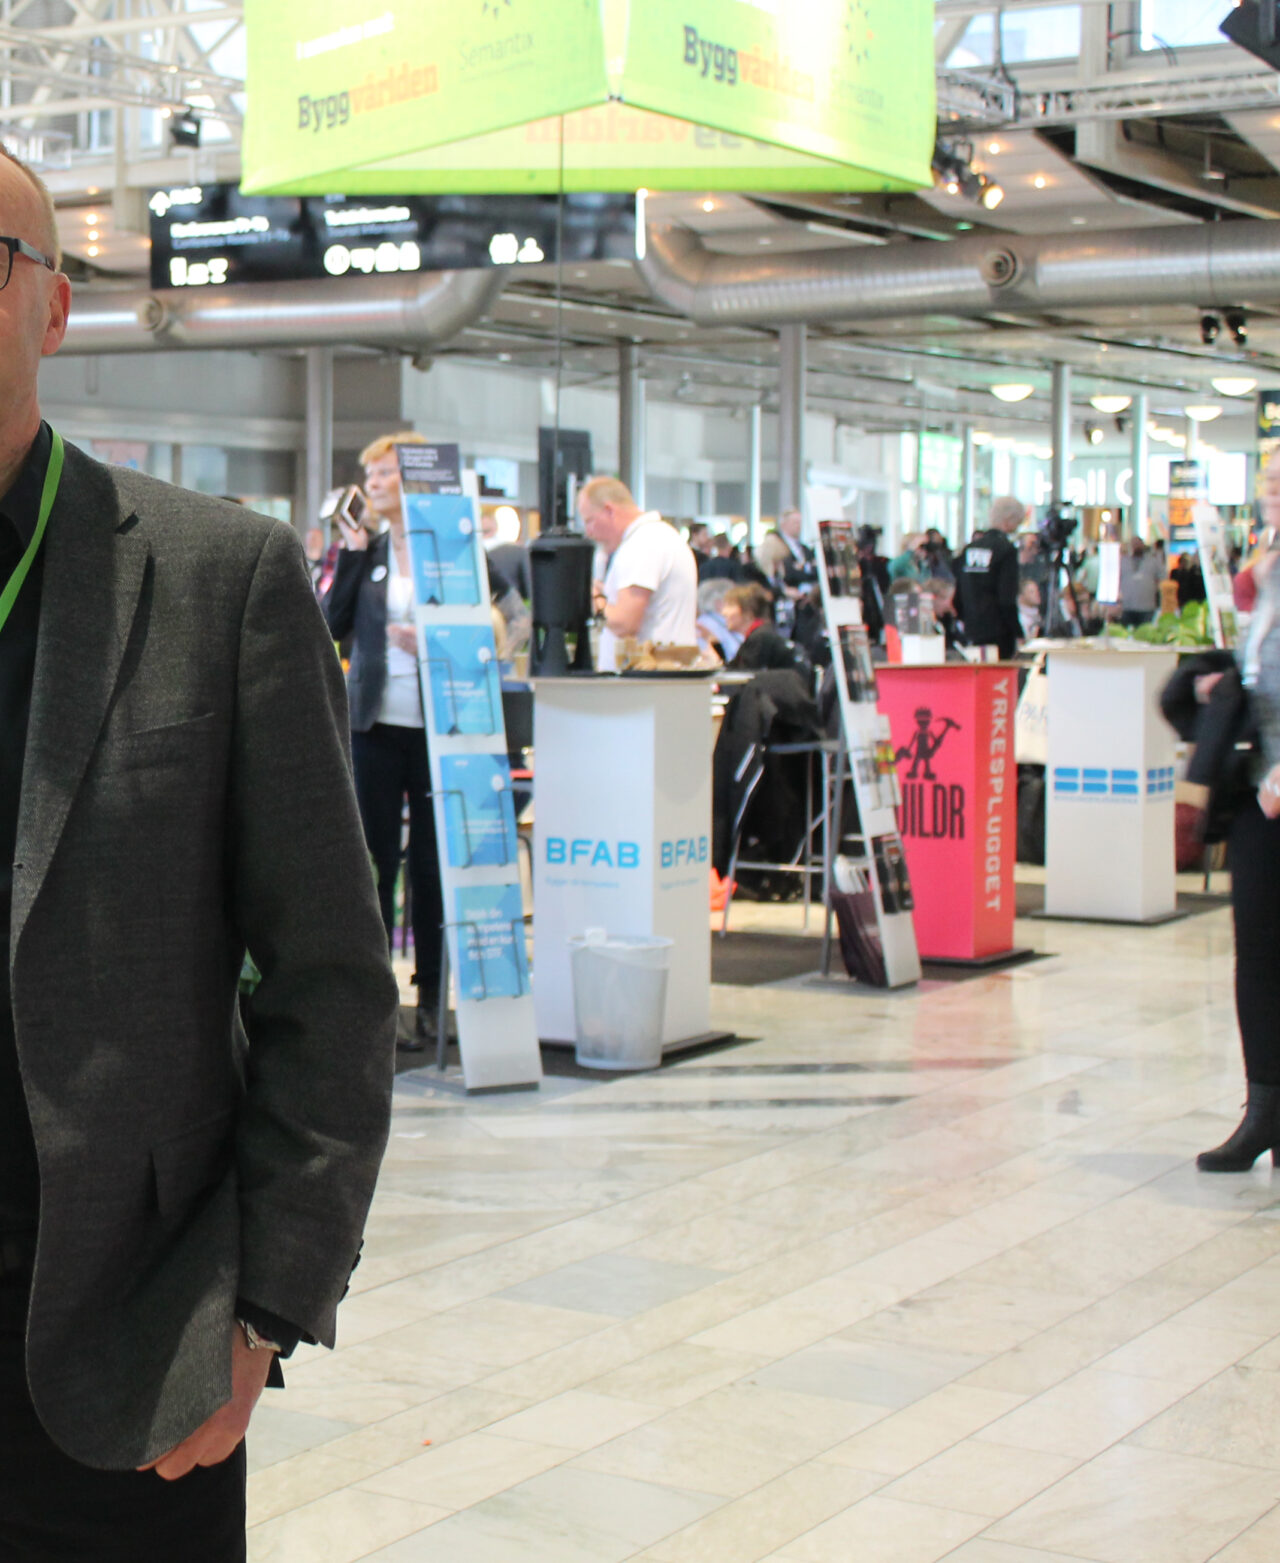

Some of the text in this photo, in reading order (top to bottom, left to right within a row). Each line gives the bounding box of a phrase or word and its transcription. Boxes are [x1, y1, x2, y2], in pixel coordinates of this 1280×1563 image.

[896, 783, 965, 840] UILDR
[985, 678, 1008, 911] YRKESPLUGGET
[546, 837, 640, 869] BFAB
[661, 836, 708, 868] BFAB
